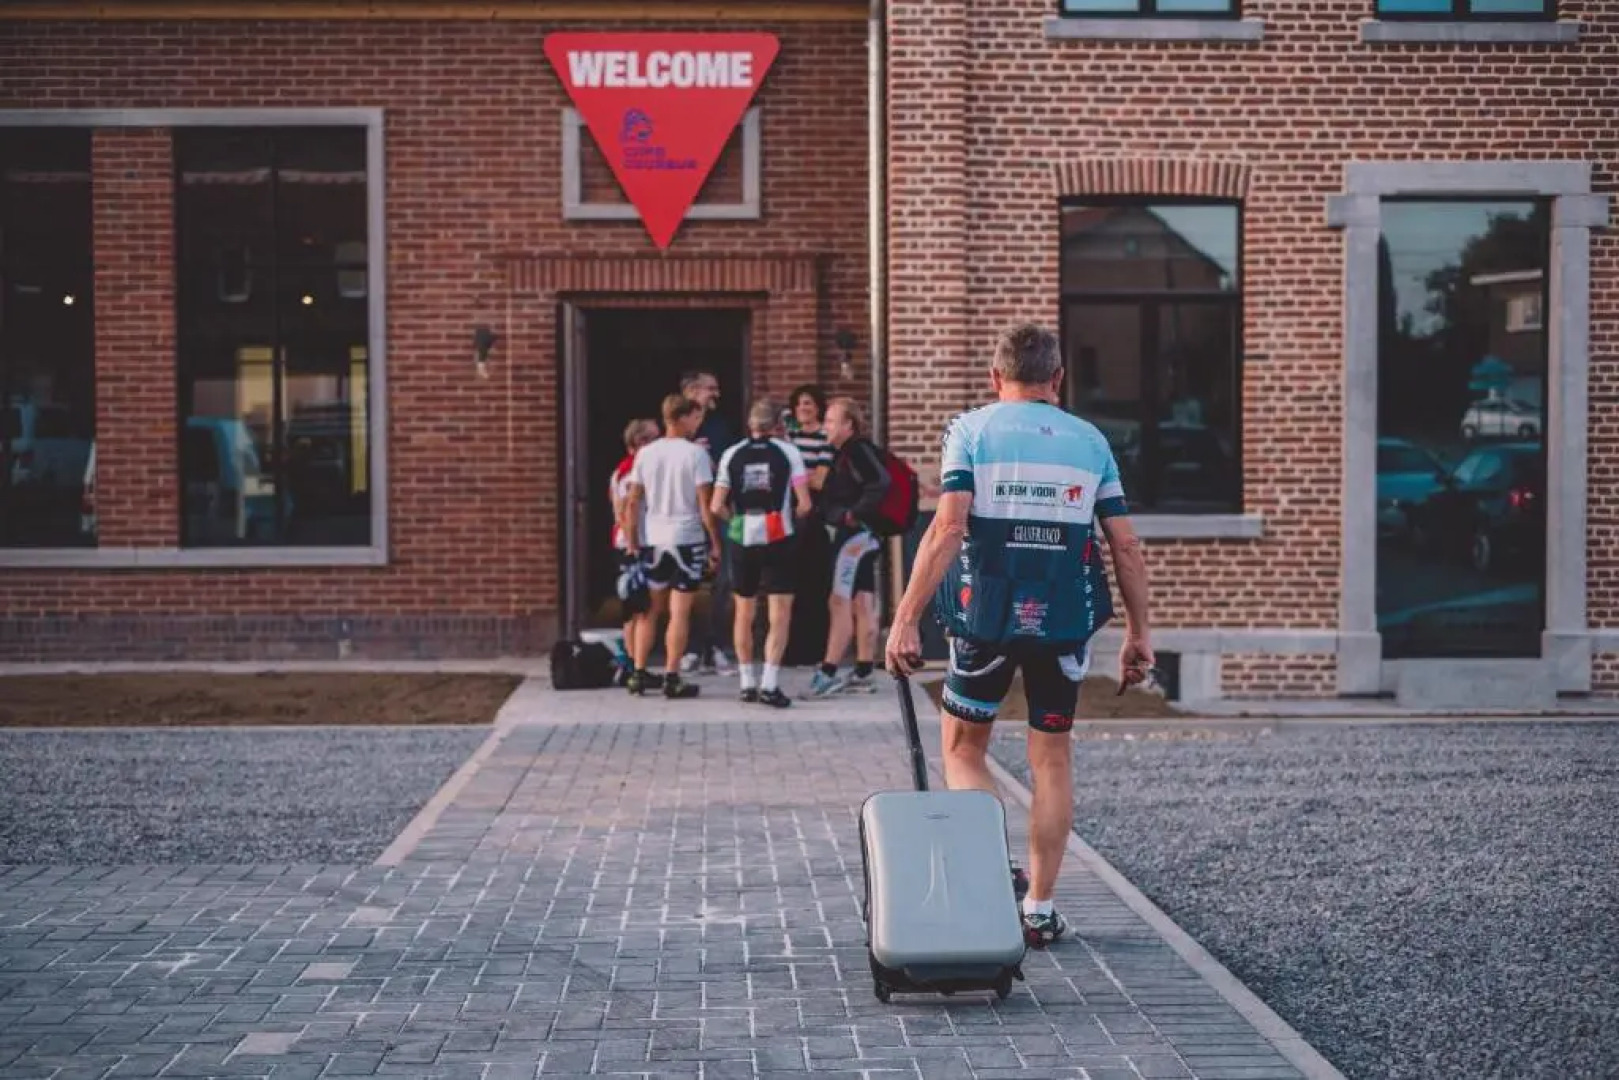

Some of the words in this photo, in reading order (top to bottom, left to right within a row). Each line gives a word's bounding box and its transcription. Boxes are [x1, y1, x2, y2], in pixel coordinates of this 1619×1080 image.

[567, 50, 754, 88] WELCOME
[995, 484, 1005, 496] IK
[1008, 484, 1027, 496] REM
[1031, 486, 1057, 498] VOOR
